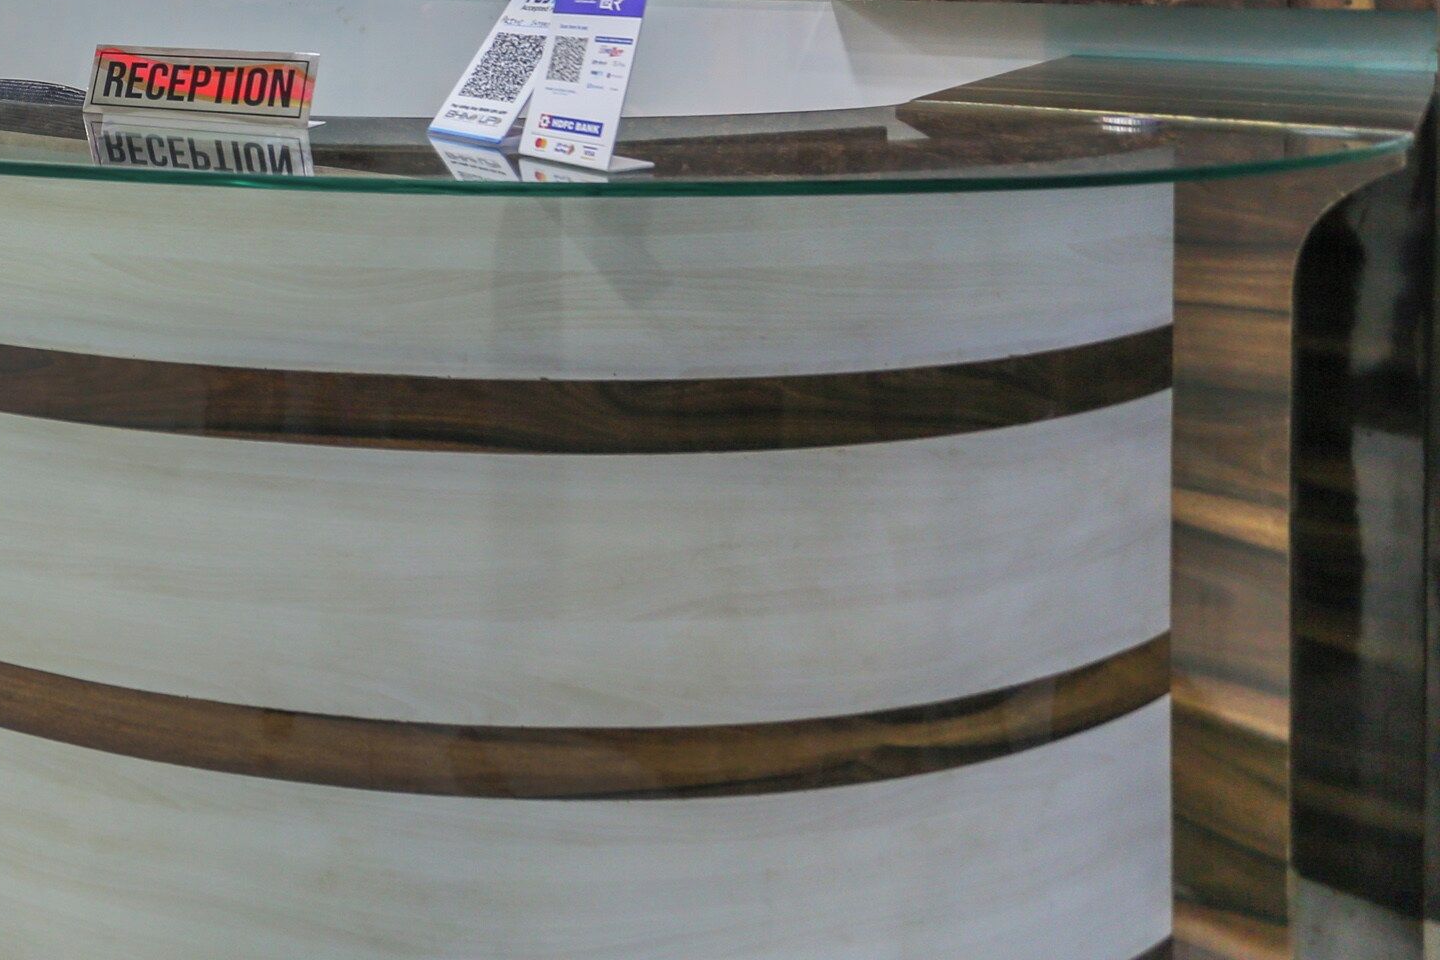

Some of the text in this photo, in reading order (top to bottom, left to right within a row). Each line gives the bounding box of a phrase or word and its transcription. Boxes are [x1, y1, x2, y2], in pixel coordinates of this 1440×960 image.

[102, 61, 296, 108] RECEPTION
[550, 118, 601, 135] HDFC BANK
